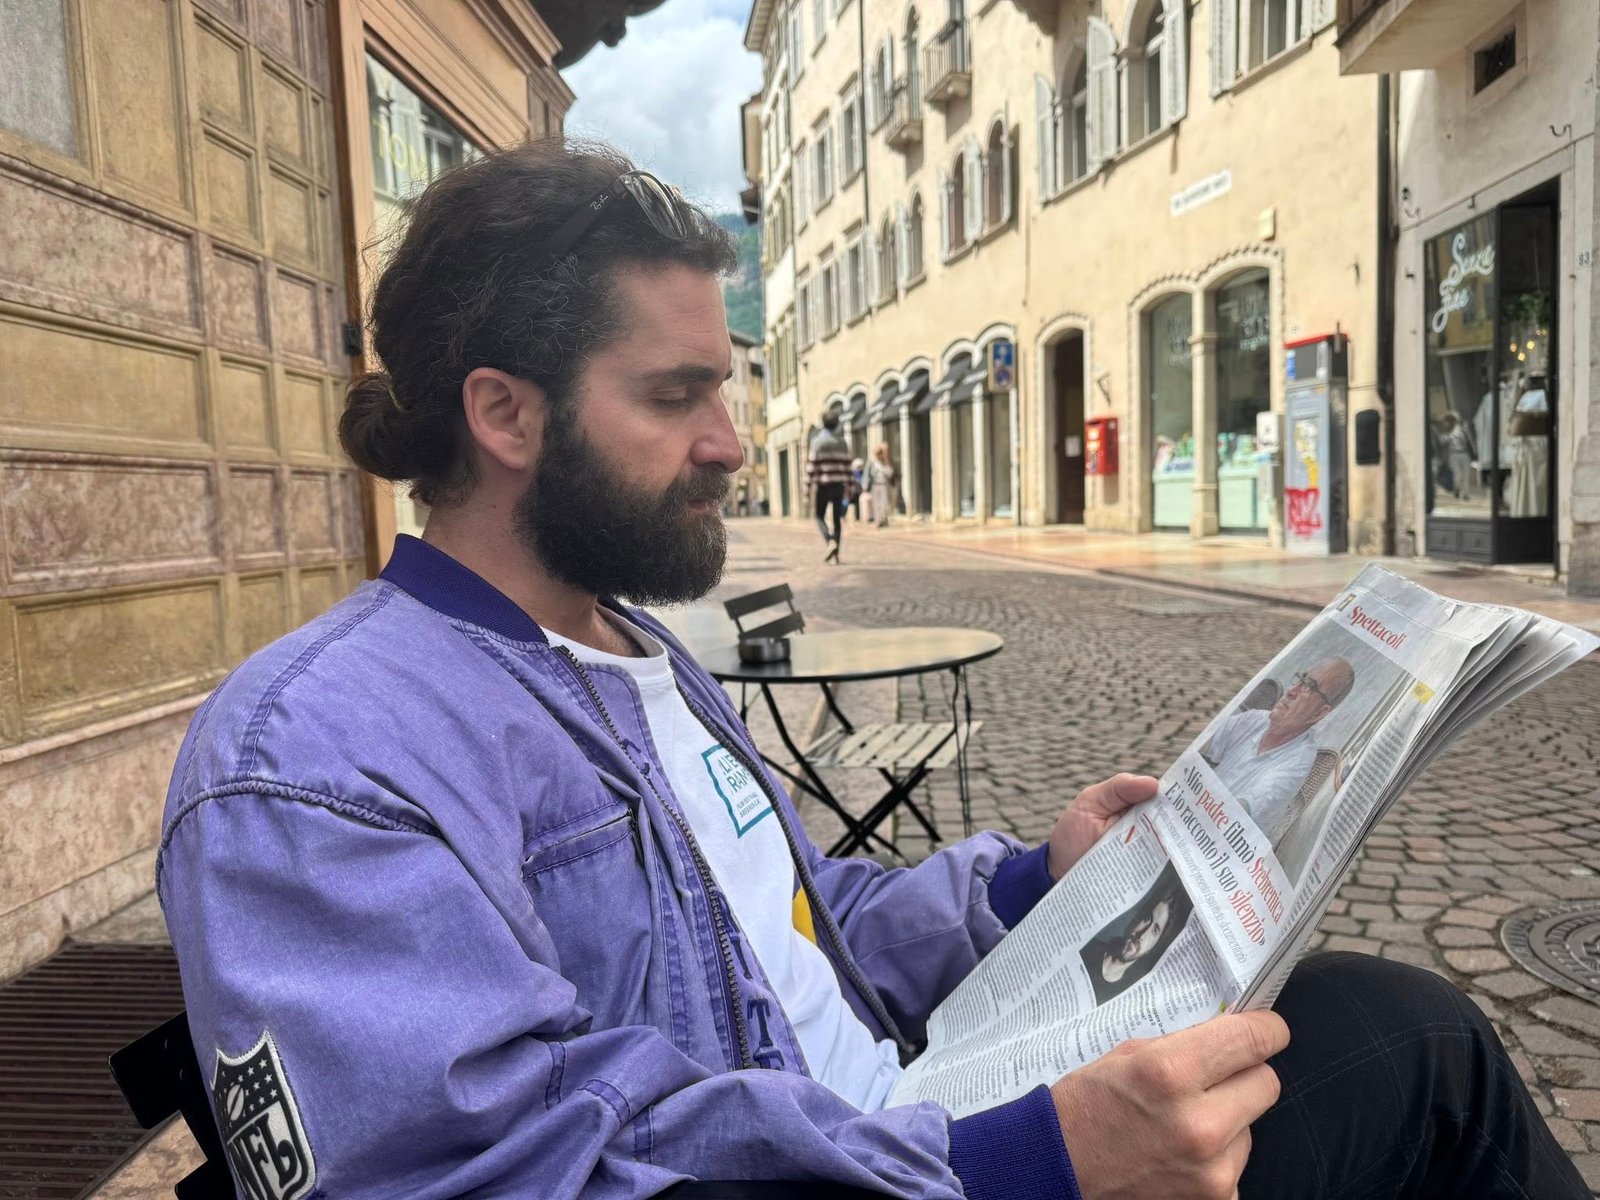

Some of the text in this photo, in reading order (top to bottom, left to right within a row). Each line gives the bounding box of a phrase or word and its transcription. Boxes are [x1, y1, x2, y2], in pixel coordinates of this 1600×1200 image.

[1347, 605, 1408, 650] Spettacoli
[1165, 782, 1179, 801] E
[1172, 796, 1186, 812] io
[1180, 805, 1218, 861] racconto
[1194, 788, 1229, 829] padre
[1223, 820, 1257, 864] filmò
[1247, 856, 1285, 925] Srebrenica
[1209, 853, 1227, 871] il
[1216, 866, 1239, 892] suo
[1228, 889, 1266, 947] silenzio»
[228, 1112, 298, 1200] NFL
